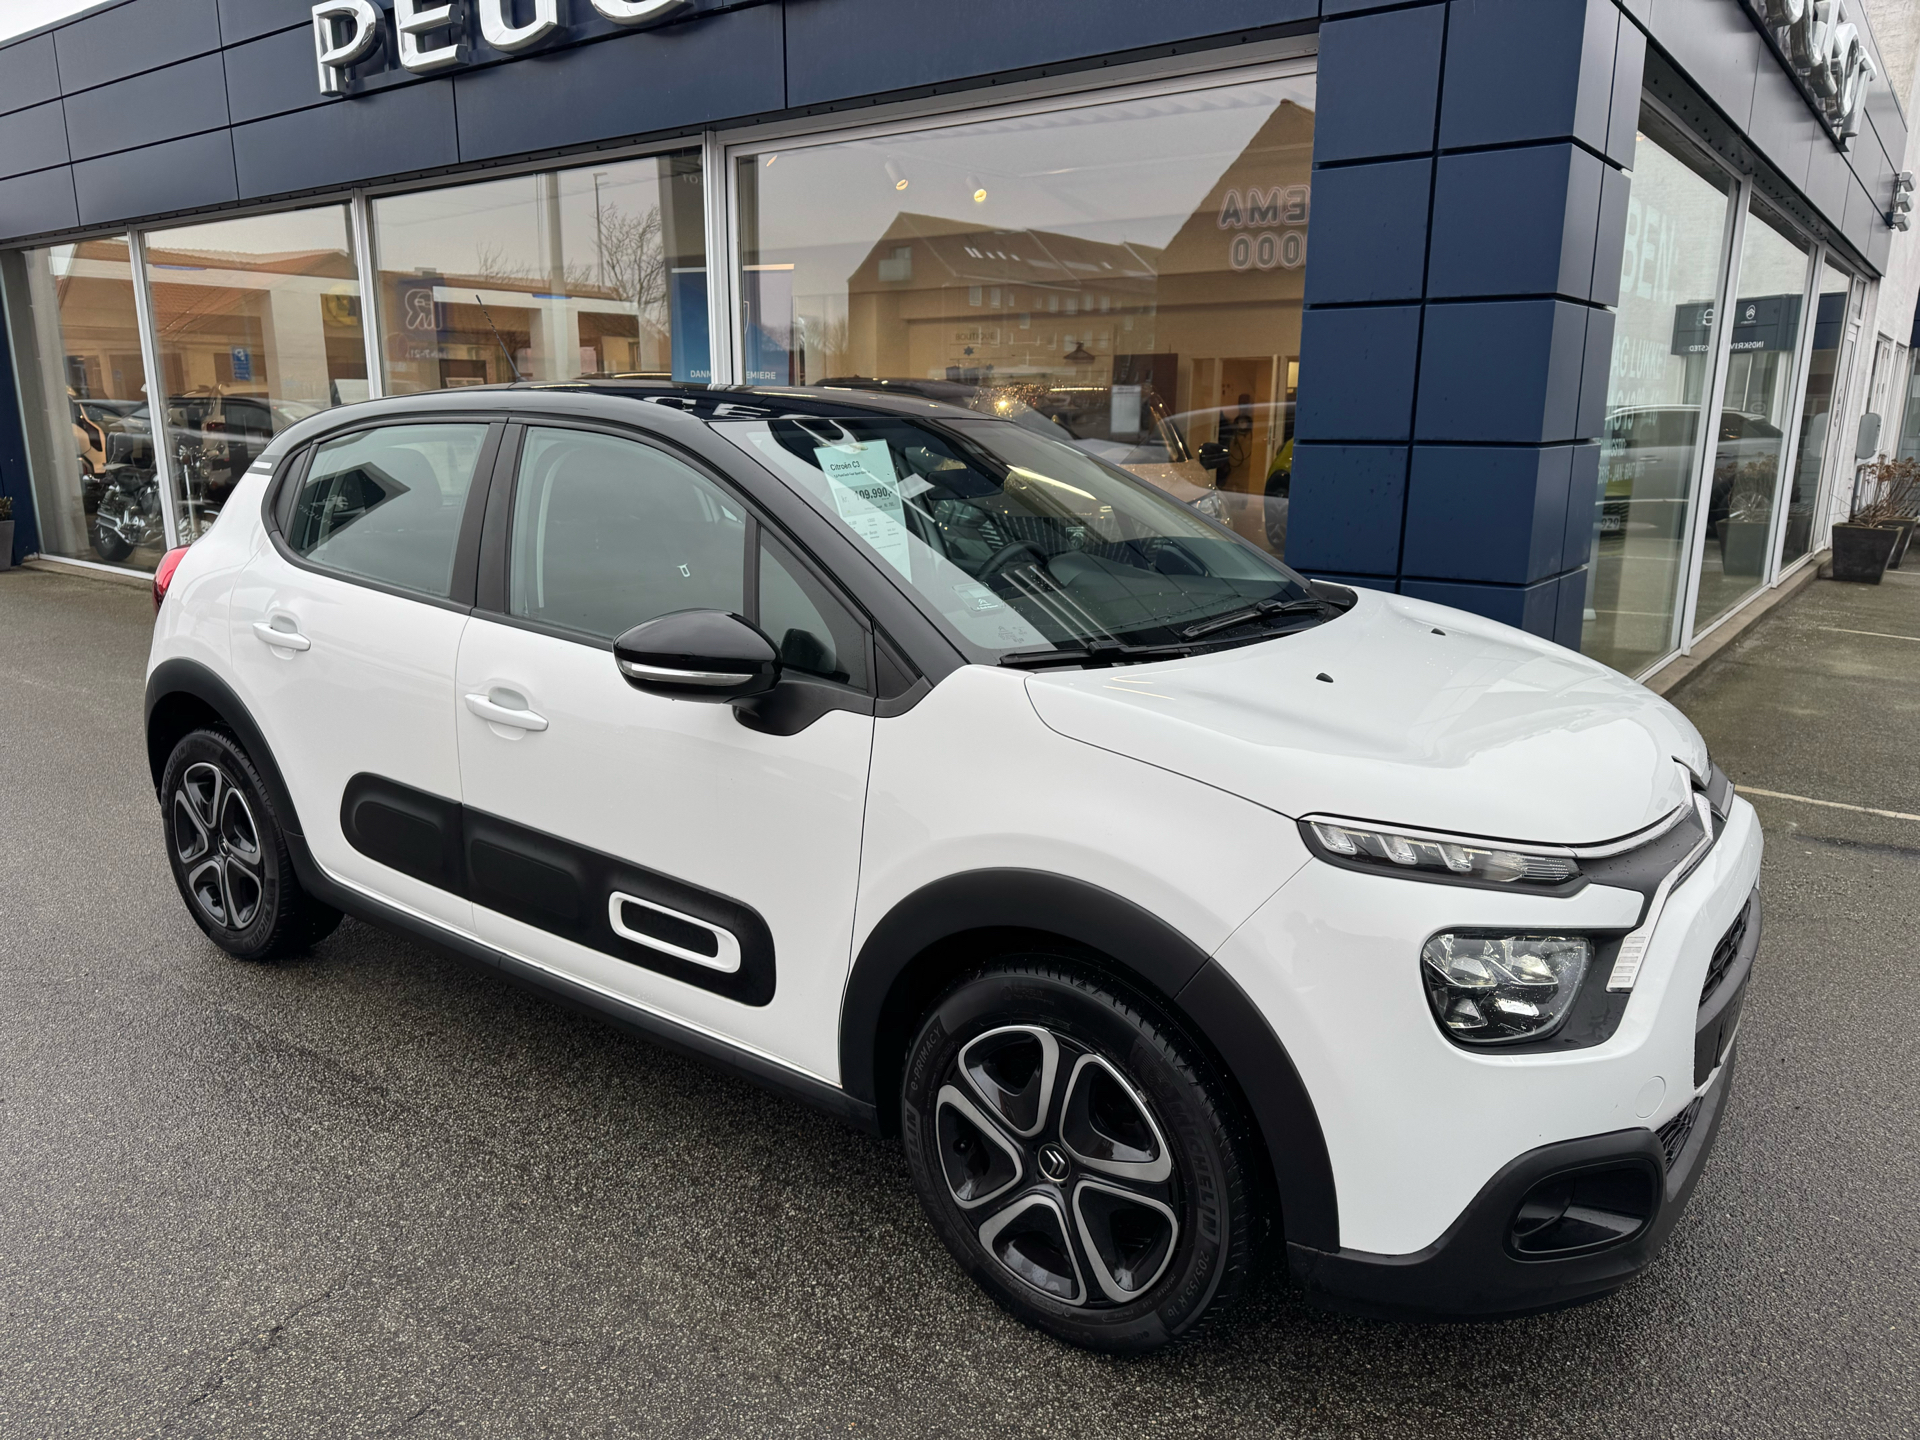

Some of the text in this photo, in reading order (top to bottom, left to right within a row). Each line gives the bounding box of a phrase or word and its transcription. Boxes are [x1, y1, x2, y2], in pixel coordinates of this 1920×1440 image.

[830, 460, 860, 472] Citroën C3
[1168, 1101, 1217, 1237] MICHELIN
[1185, 1249, 1210, 1297] 205/55
[1177, 1295, 1189, 1308] R
